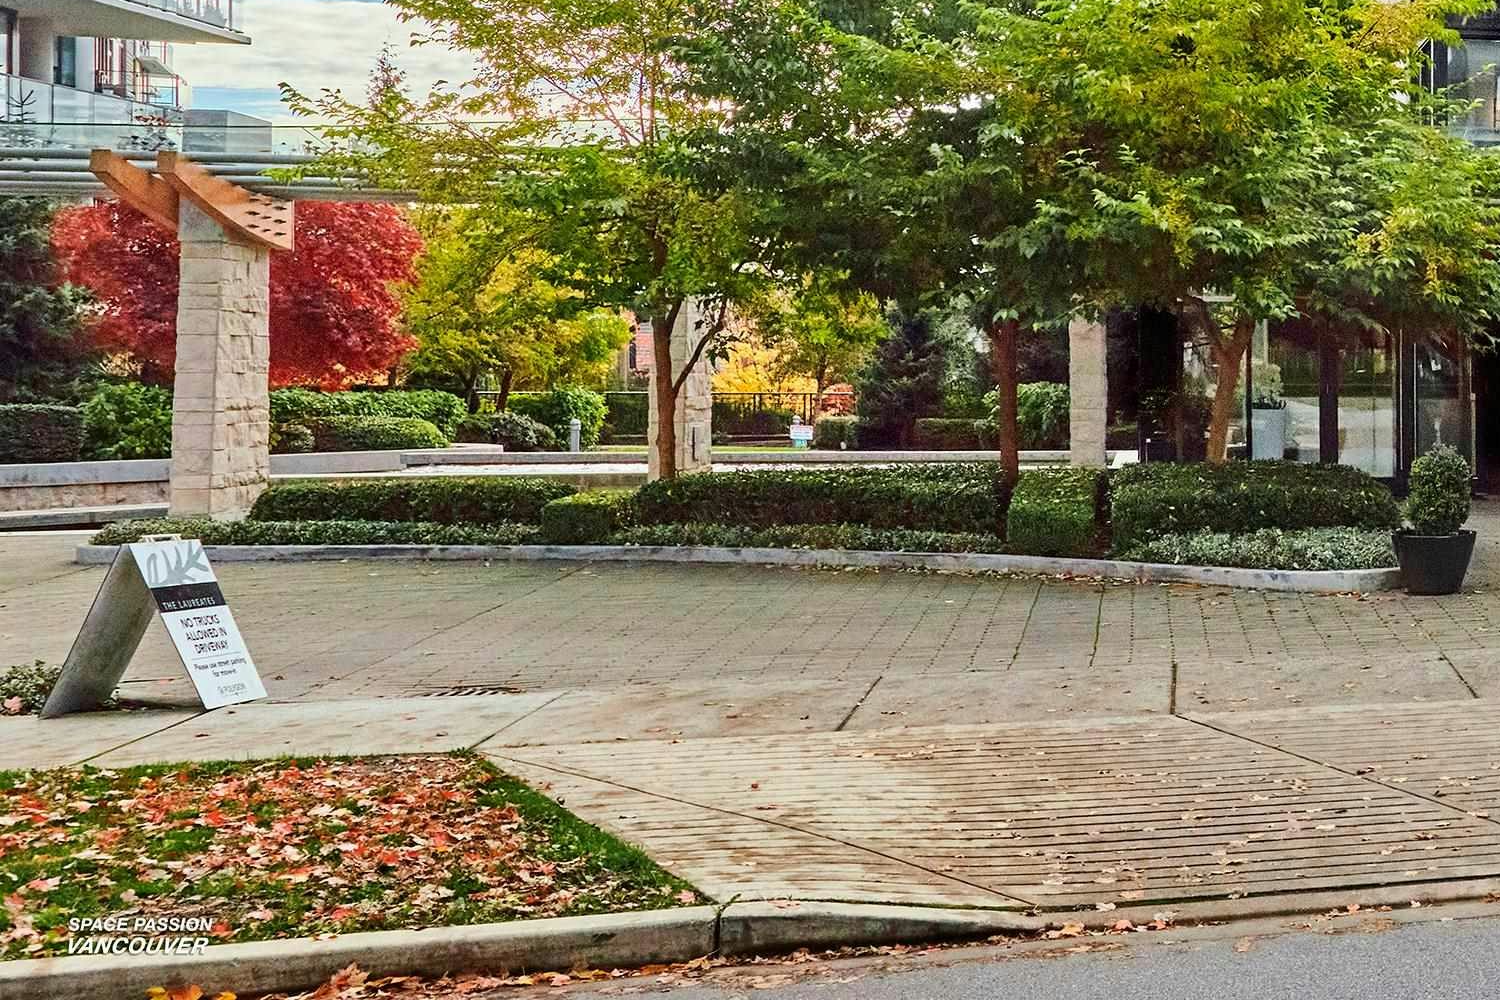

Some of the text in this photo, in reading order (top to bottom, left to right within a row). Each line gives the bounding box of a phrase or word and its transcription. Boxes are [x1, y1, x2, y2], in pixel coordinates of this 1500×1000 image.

[162, 597, 216, 611] THE LAUREATES
[180, 614, 220, 627] NO TRUCKS
[186, 627, 227, 640] ALLOWED IN
[194, 640, 228, 653] DRIVEWAY
